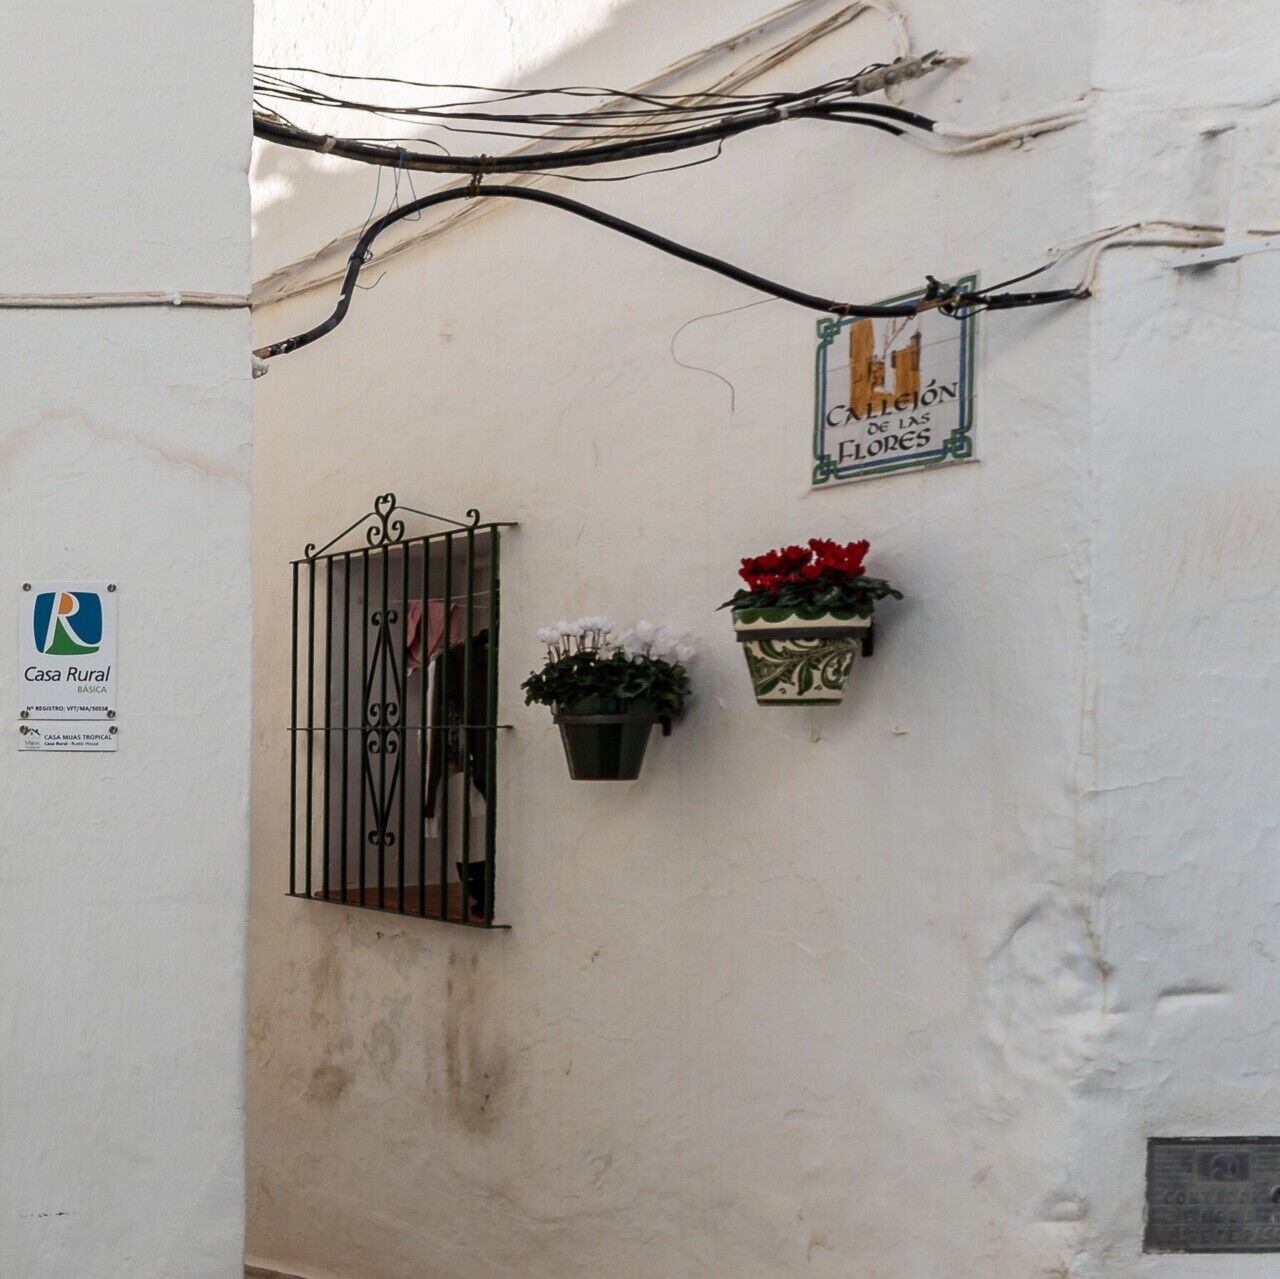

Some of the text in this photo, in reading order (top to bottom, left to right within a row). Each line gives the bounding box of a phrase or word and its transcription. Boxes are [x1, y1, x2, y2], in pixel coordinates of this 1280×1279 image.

[826, 378, 958, 428] CALLEJÓN
[867, 412, 931, 436] DE LAS
[838, 427, 932, 465] FLORES
[24, 665, 111, 682] Casa Rural
